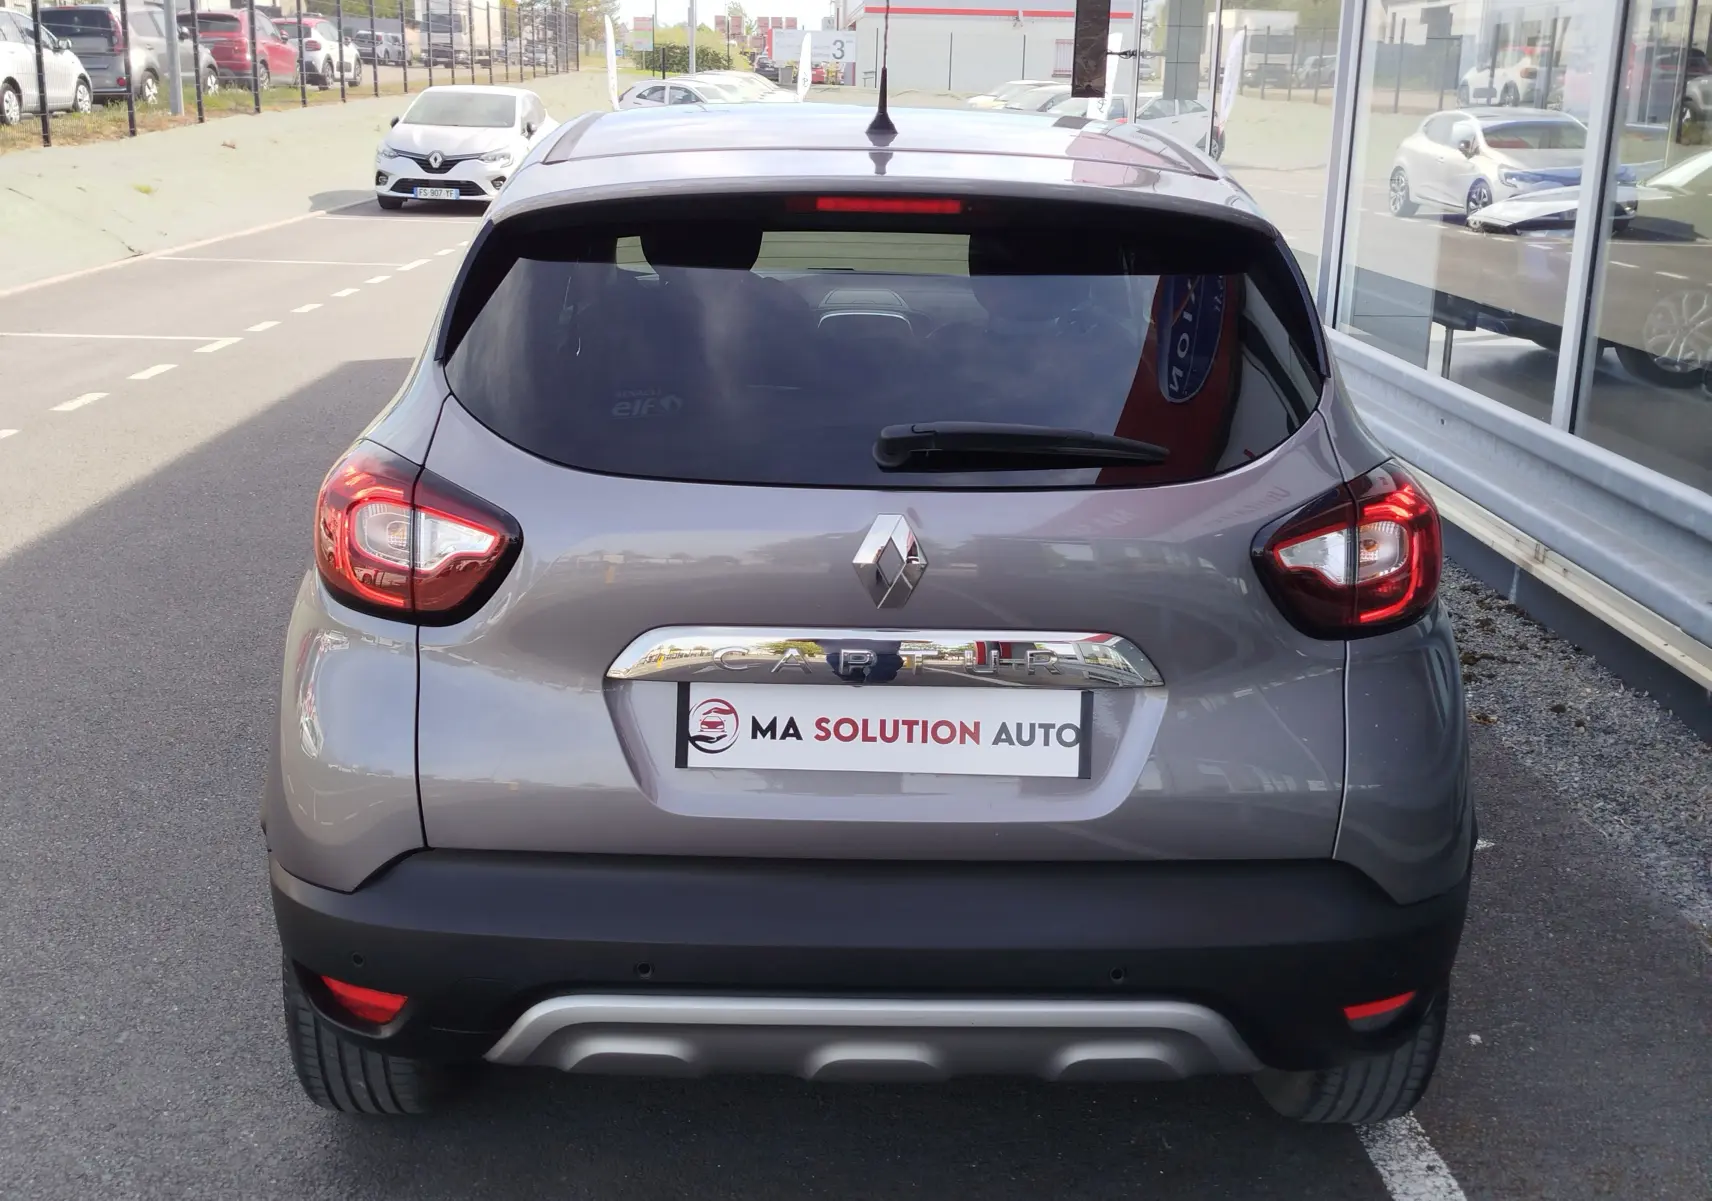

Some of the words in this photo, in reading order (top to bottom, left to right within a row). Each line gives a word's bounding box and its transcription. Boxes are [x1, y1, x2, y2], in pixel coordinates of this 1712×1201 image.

[832, 39, 845, 60] 3
[419, 188, 428, 197] FS
[430, 189, 443, 197] 907
[445, 189, 454, 197] YF
[611, 398, 656, 416] elf
[712, 646, 1061, 676] CAPTUR
[751, 715, 803, 741] MA
[814, 717, 980, 745] SOLUTION
[991, 721, 1081, 748] AUTO
